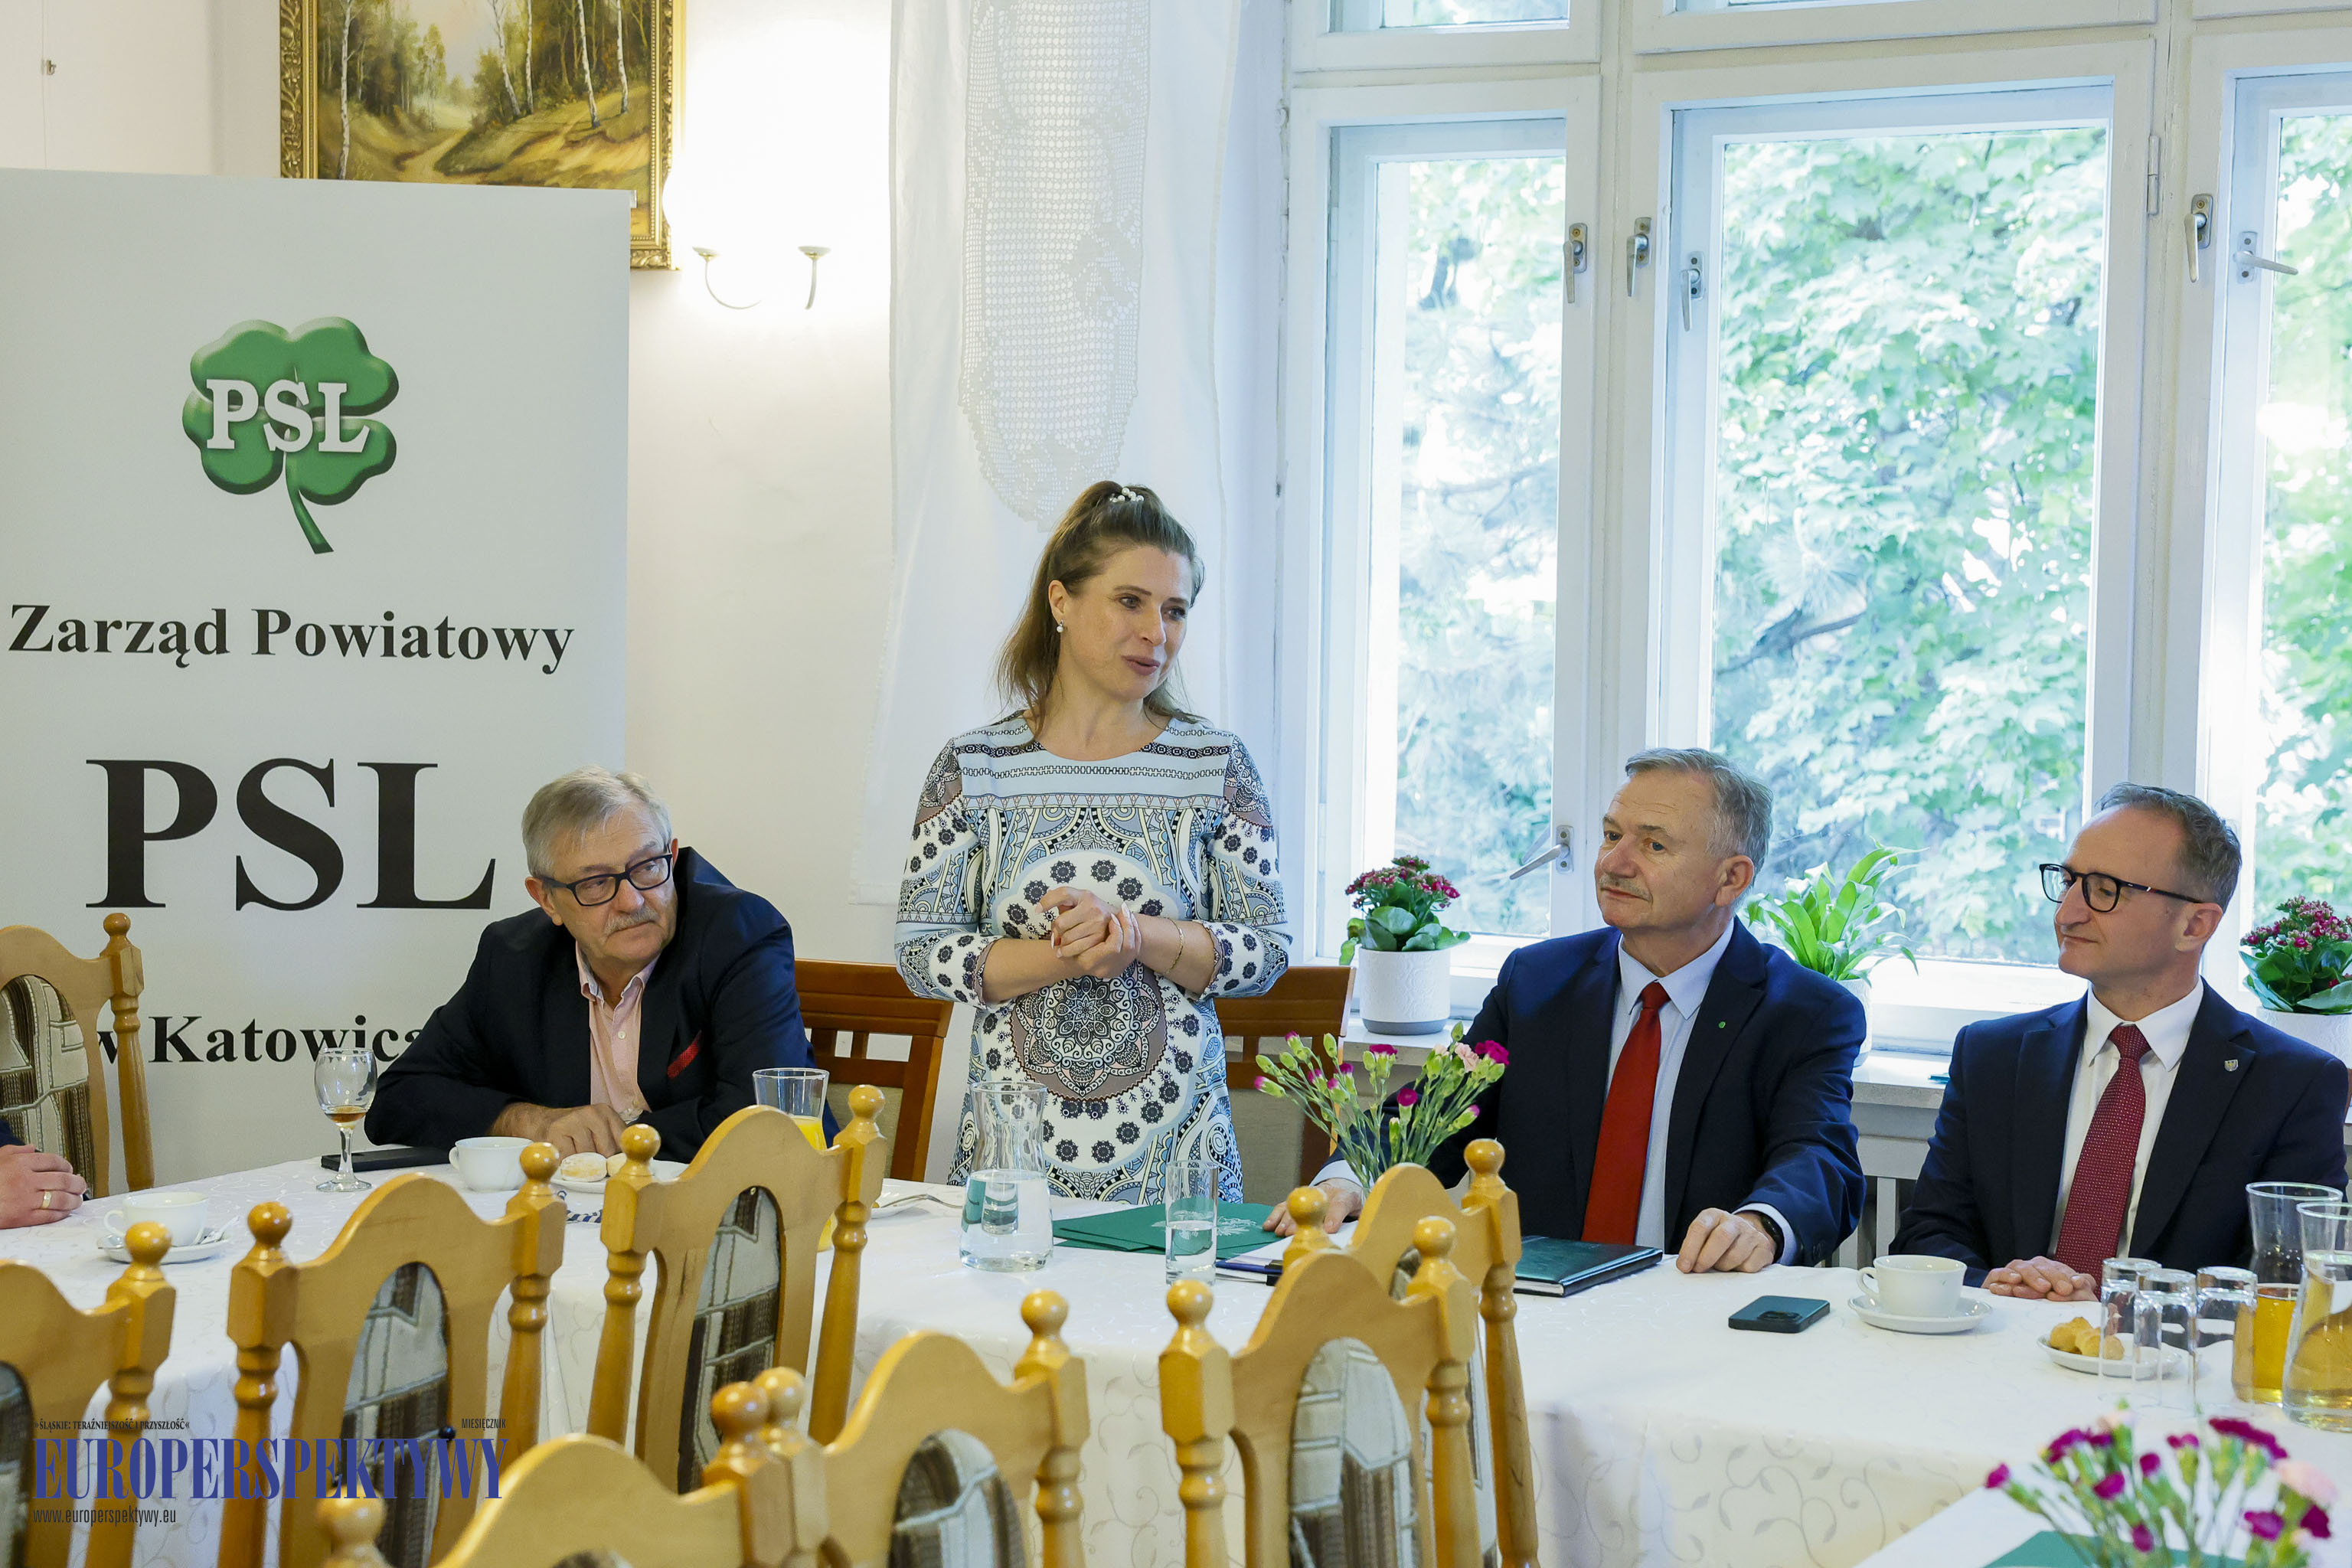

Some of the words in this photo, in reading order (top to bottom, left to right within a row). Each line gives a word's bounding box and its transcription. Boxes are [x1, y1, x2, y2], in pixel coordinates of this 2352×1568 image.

[206, 378, 371, 453] PSL
[8, 603, 230, 669] Zarząd
[251, 609, 574, 675] Powiatowy
[85, 757, 496, 912] PSL
[148, 1014, 423, 1063] Katowic
